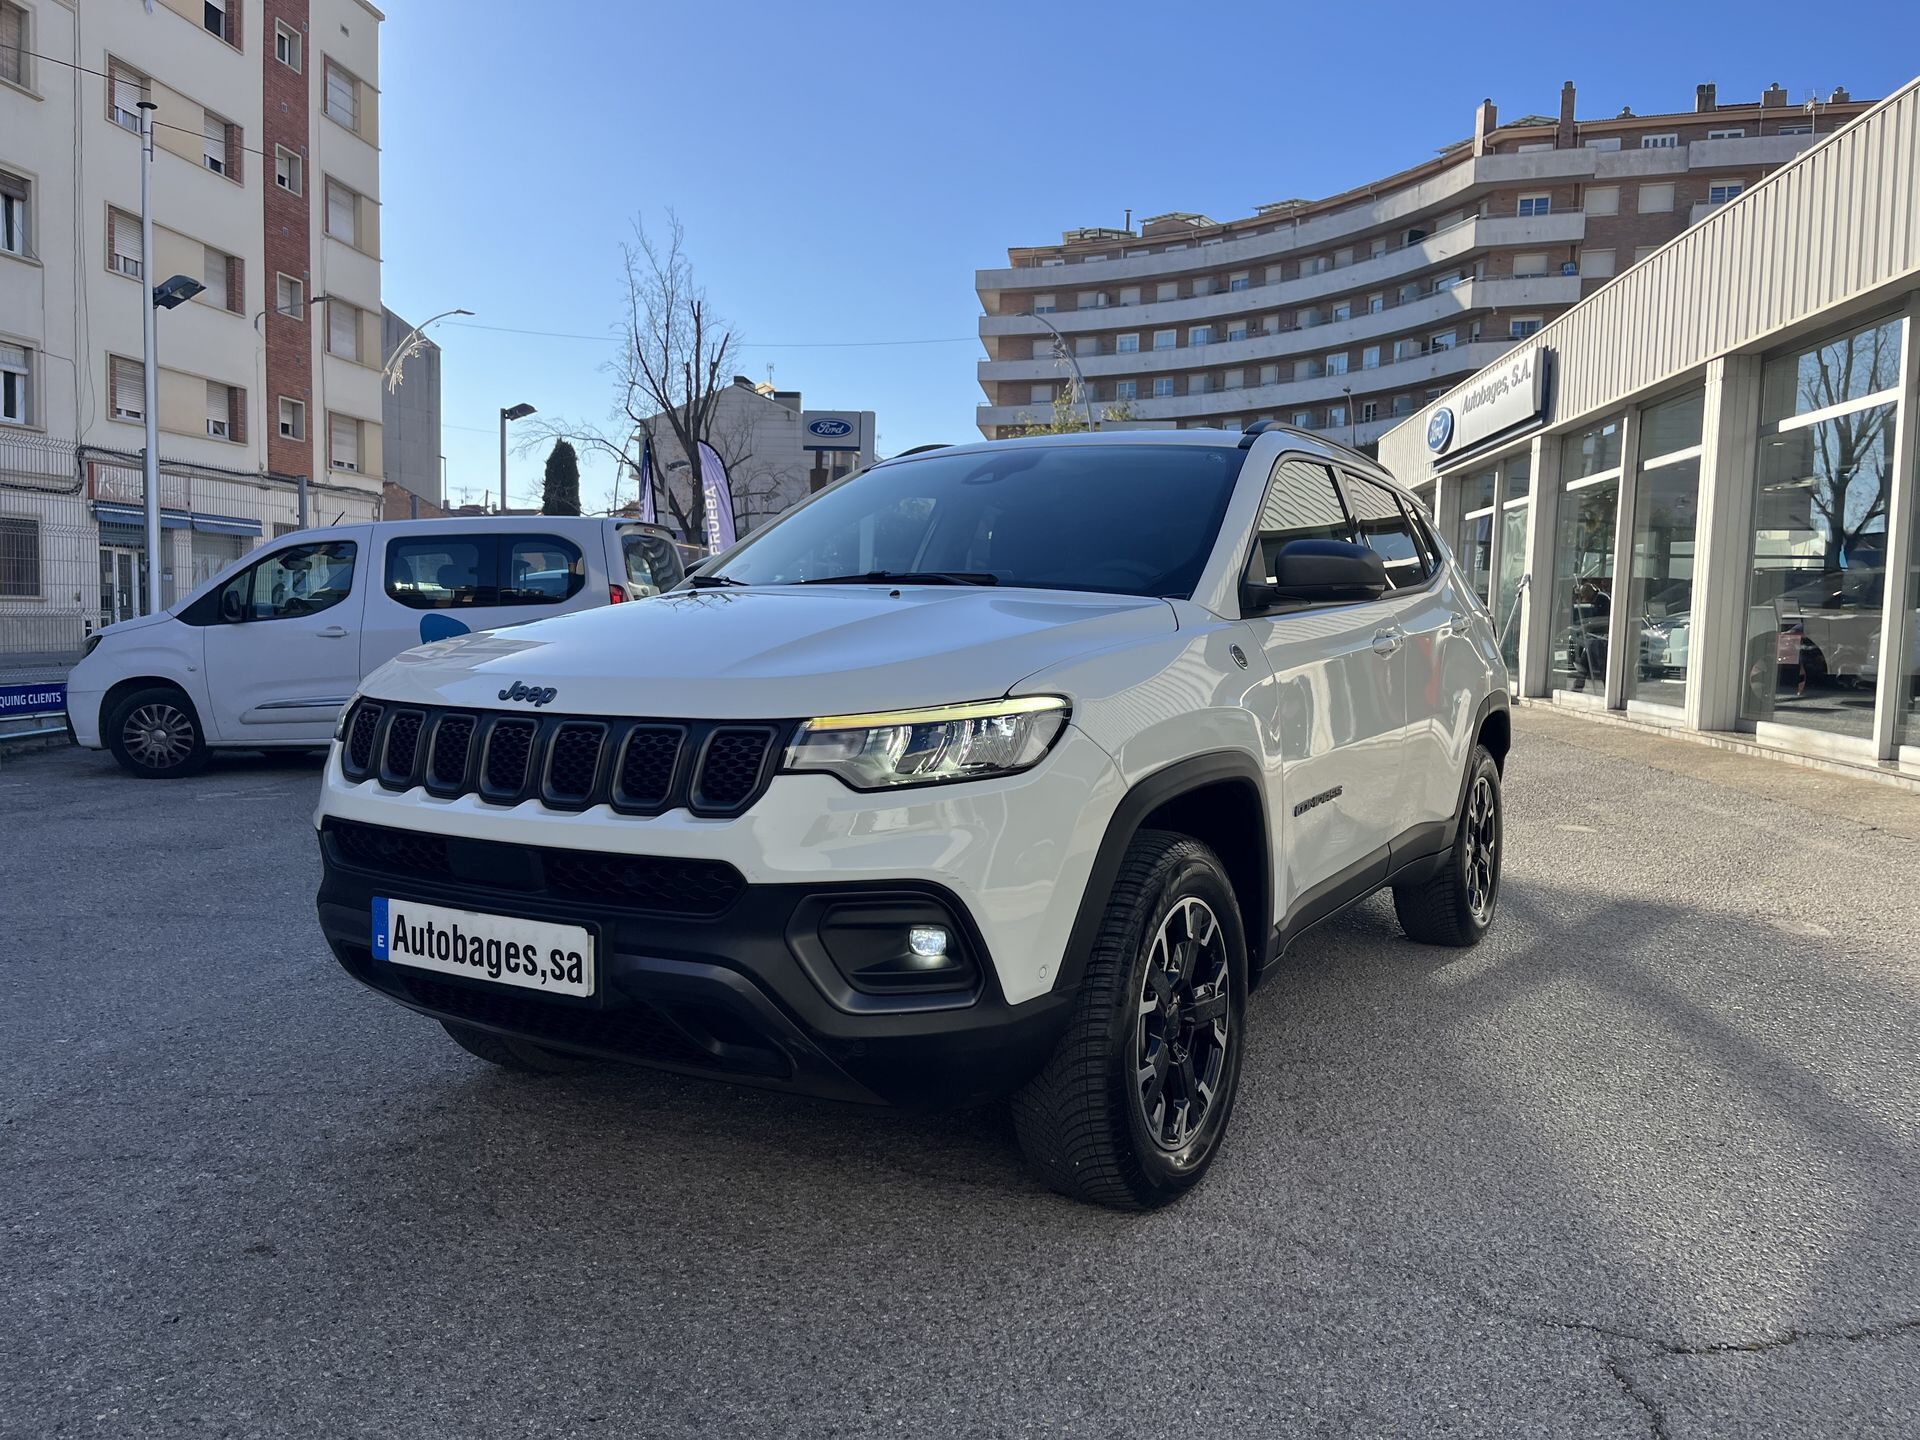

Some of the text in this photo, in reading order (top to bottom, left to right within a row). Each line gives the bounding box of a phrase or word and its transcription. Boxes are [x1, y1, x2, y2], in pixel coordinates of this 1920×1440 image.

[1462, 358, 1531, 415] Autobages, S.A.
[817, 421, 844, 434] Ford
[704, 485, 721, 556] PRUEBA
[28, 692, 61, 704] CLIENTS
[498, 680, 558, 708] Jeep
[377, 934, 385, 948] E
[392, 914, 583, 985] Autobages,sa
